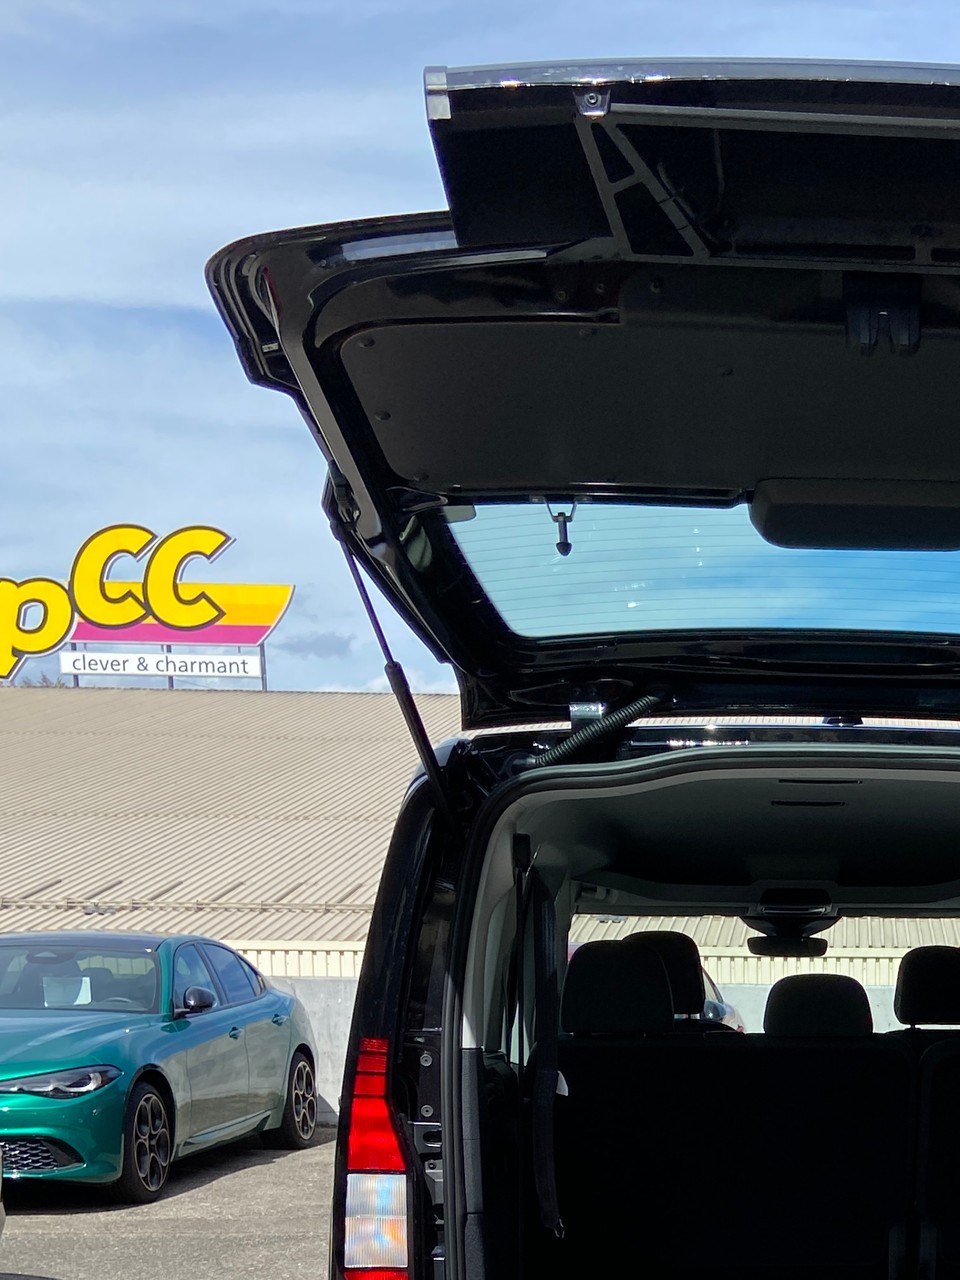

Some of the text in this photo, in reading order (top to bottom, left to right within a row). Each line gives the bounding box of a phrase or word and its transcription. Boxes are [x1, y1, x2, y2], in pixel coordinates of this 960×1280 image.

[72, 654, 249, 674] clever & charmant
